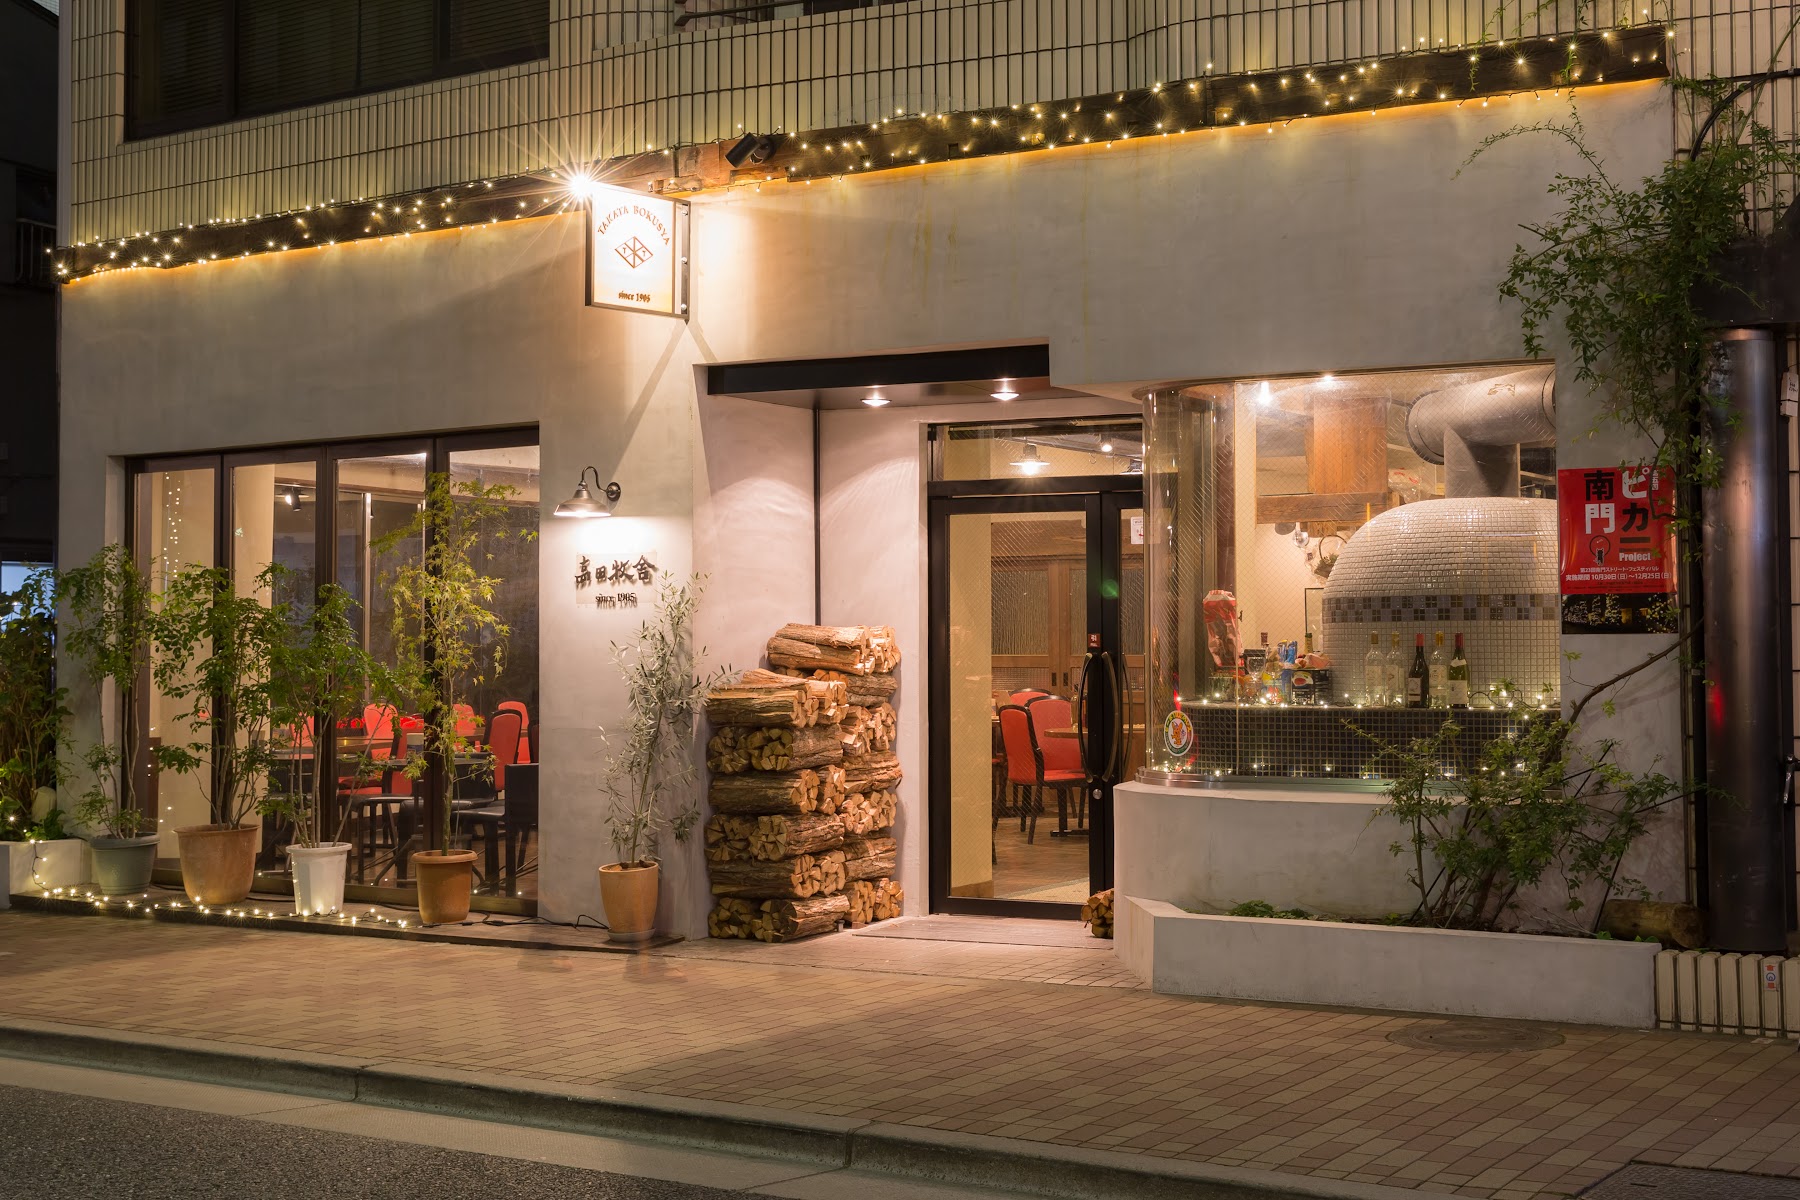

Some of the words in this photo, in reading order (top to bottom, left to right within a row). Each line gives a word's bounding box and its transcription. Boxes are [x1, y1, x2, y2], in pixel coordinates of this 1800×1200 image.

[598, 205, 629, 235] TAKATA
[633, 205, 670, 245] BOKUSYA
[618, 290, 634, 301] since
[636, 293, 651, 303] 1905
[1584, 469, 1616, 535] 南門
[1619, 552, 1651, 562] Project
[575, 554, 656, 584] 高田牧舎
[595, 593, 614, 602] since
[617, 592, 636, 602] 1905
